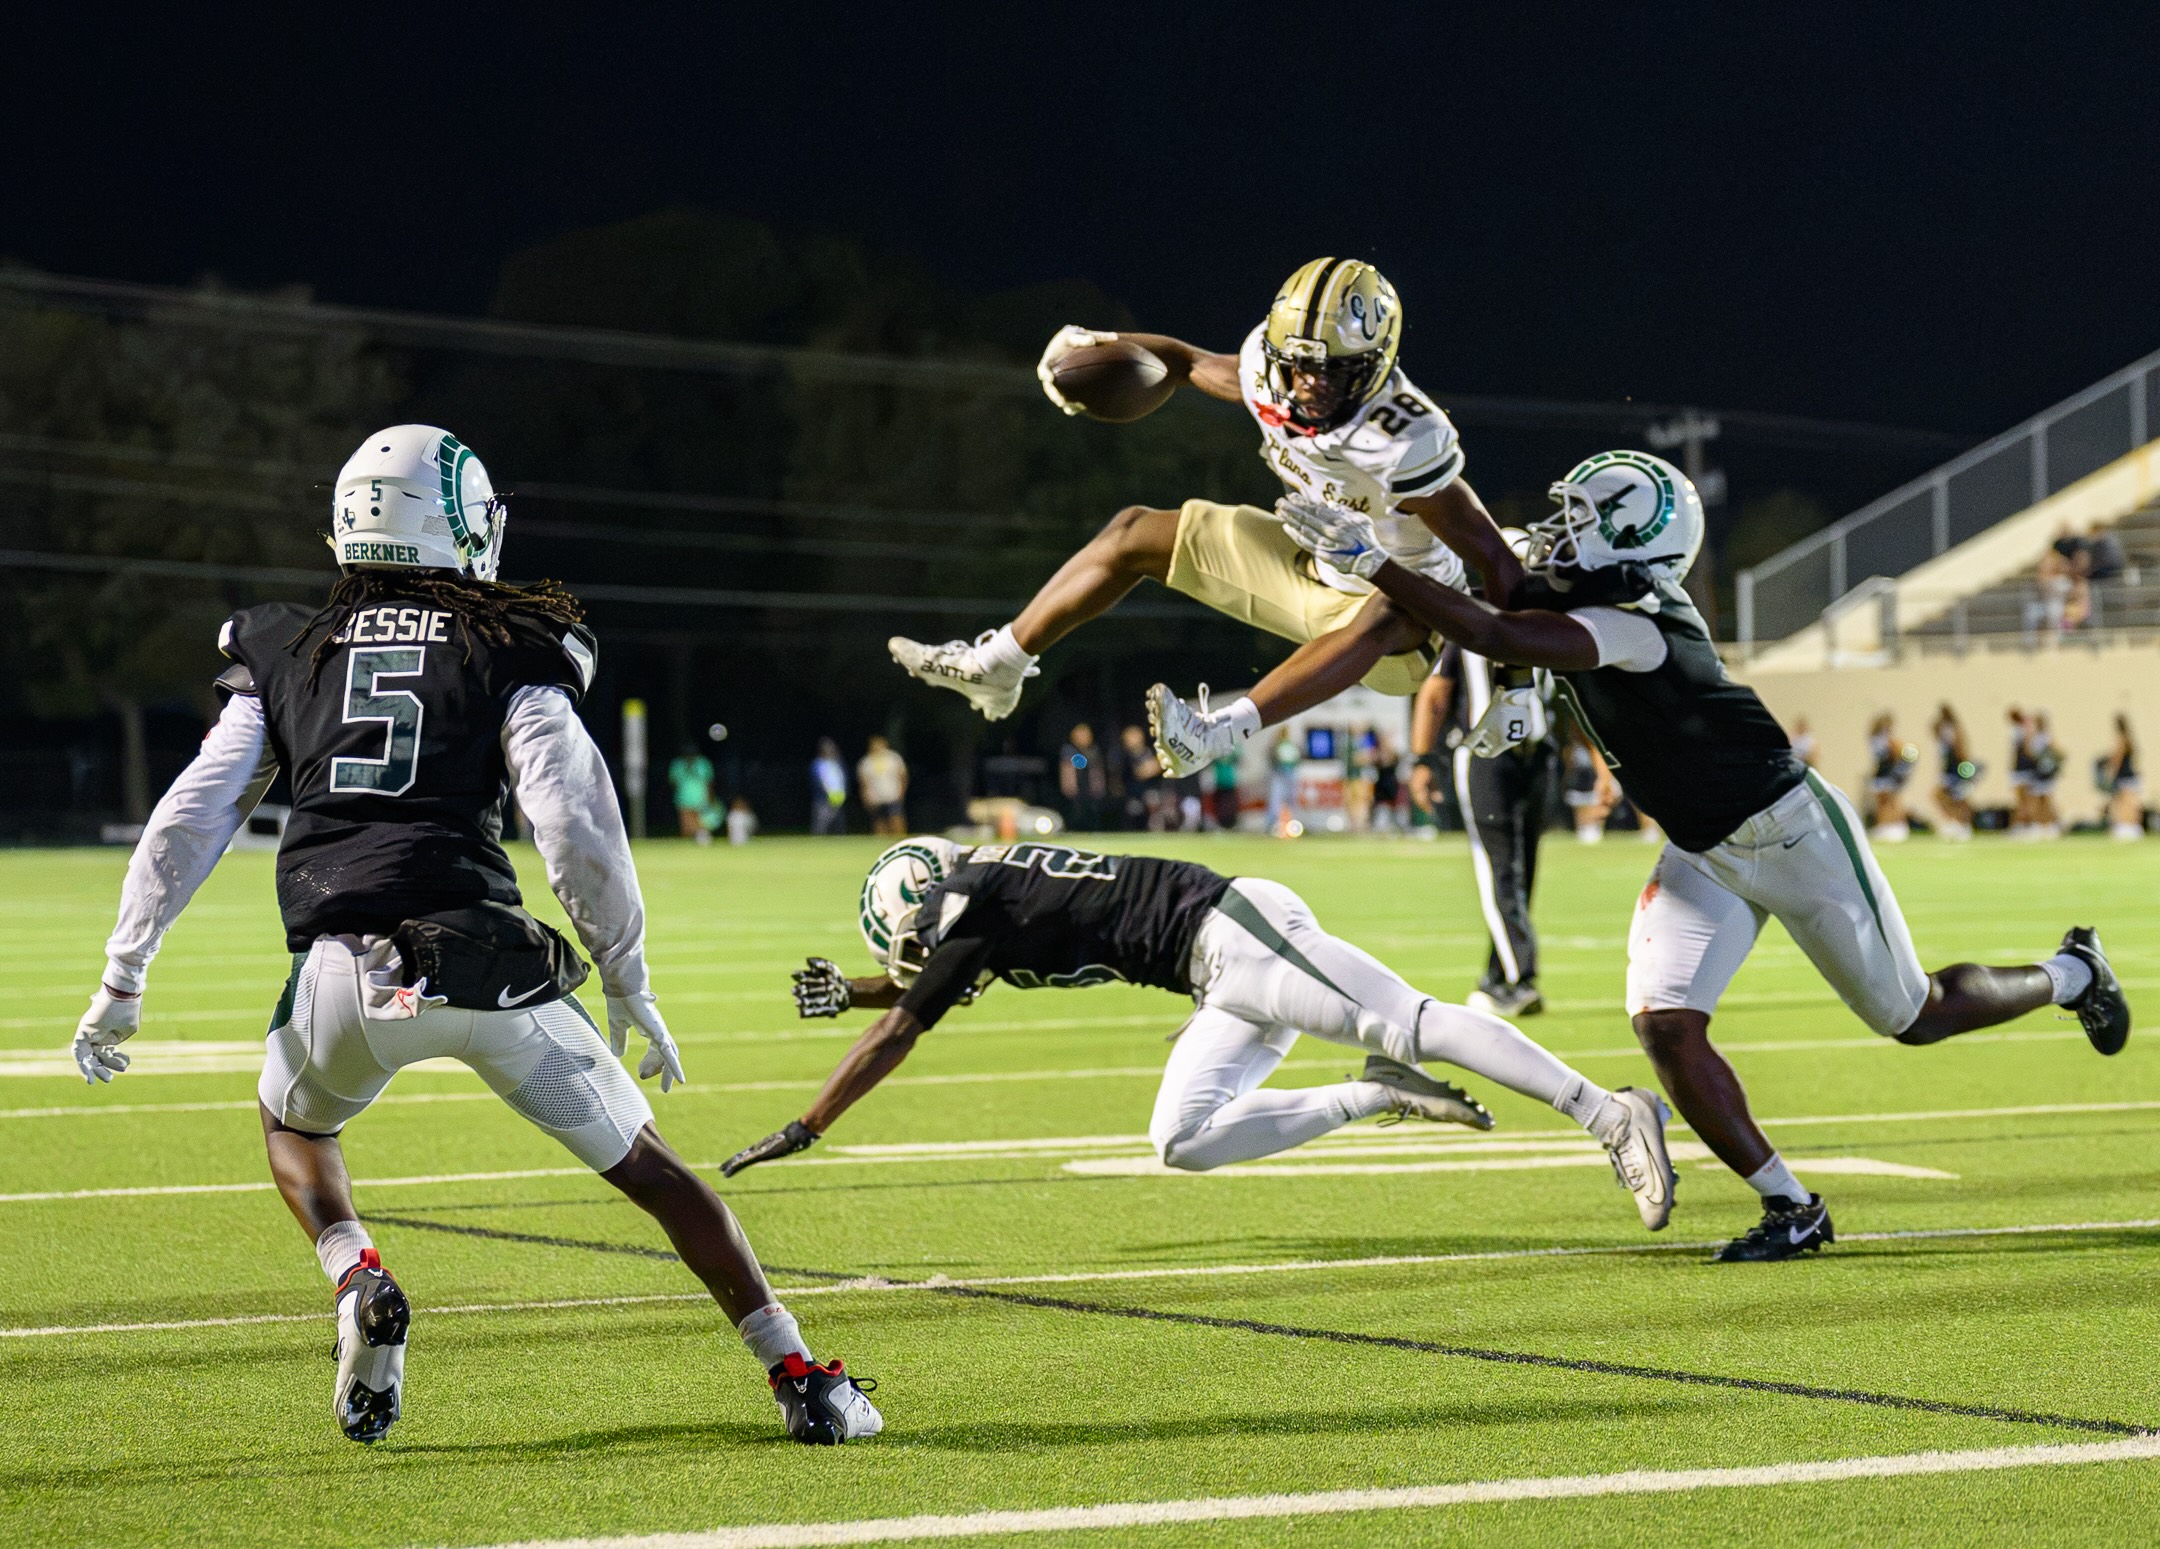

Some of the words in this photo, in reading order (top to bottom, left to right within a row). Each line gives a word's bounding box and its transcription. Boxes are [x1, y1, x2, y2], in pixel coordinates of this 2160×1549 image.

[1368, 393, 1432, 437] 28
[371, 480, 382, 502] 5
[344, 543, 420, 564] BERKNER
[331, 607, 453, 643] JESSIE
[330, 646, 425, 797] 5
